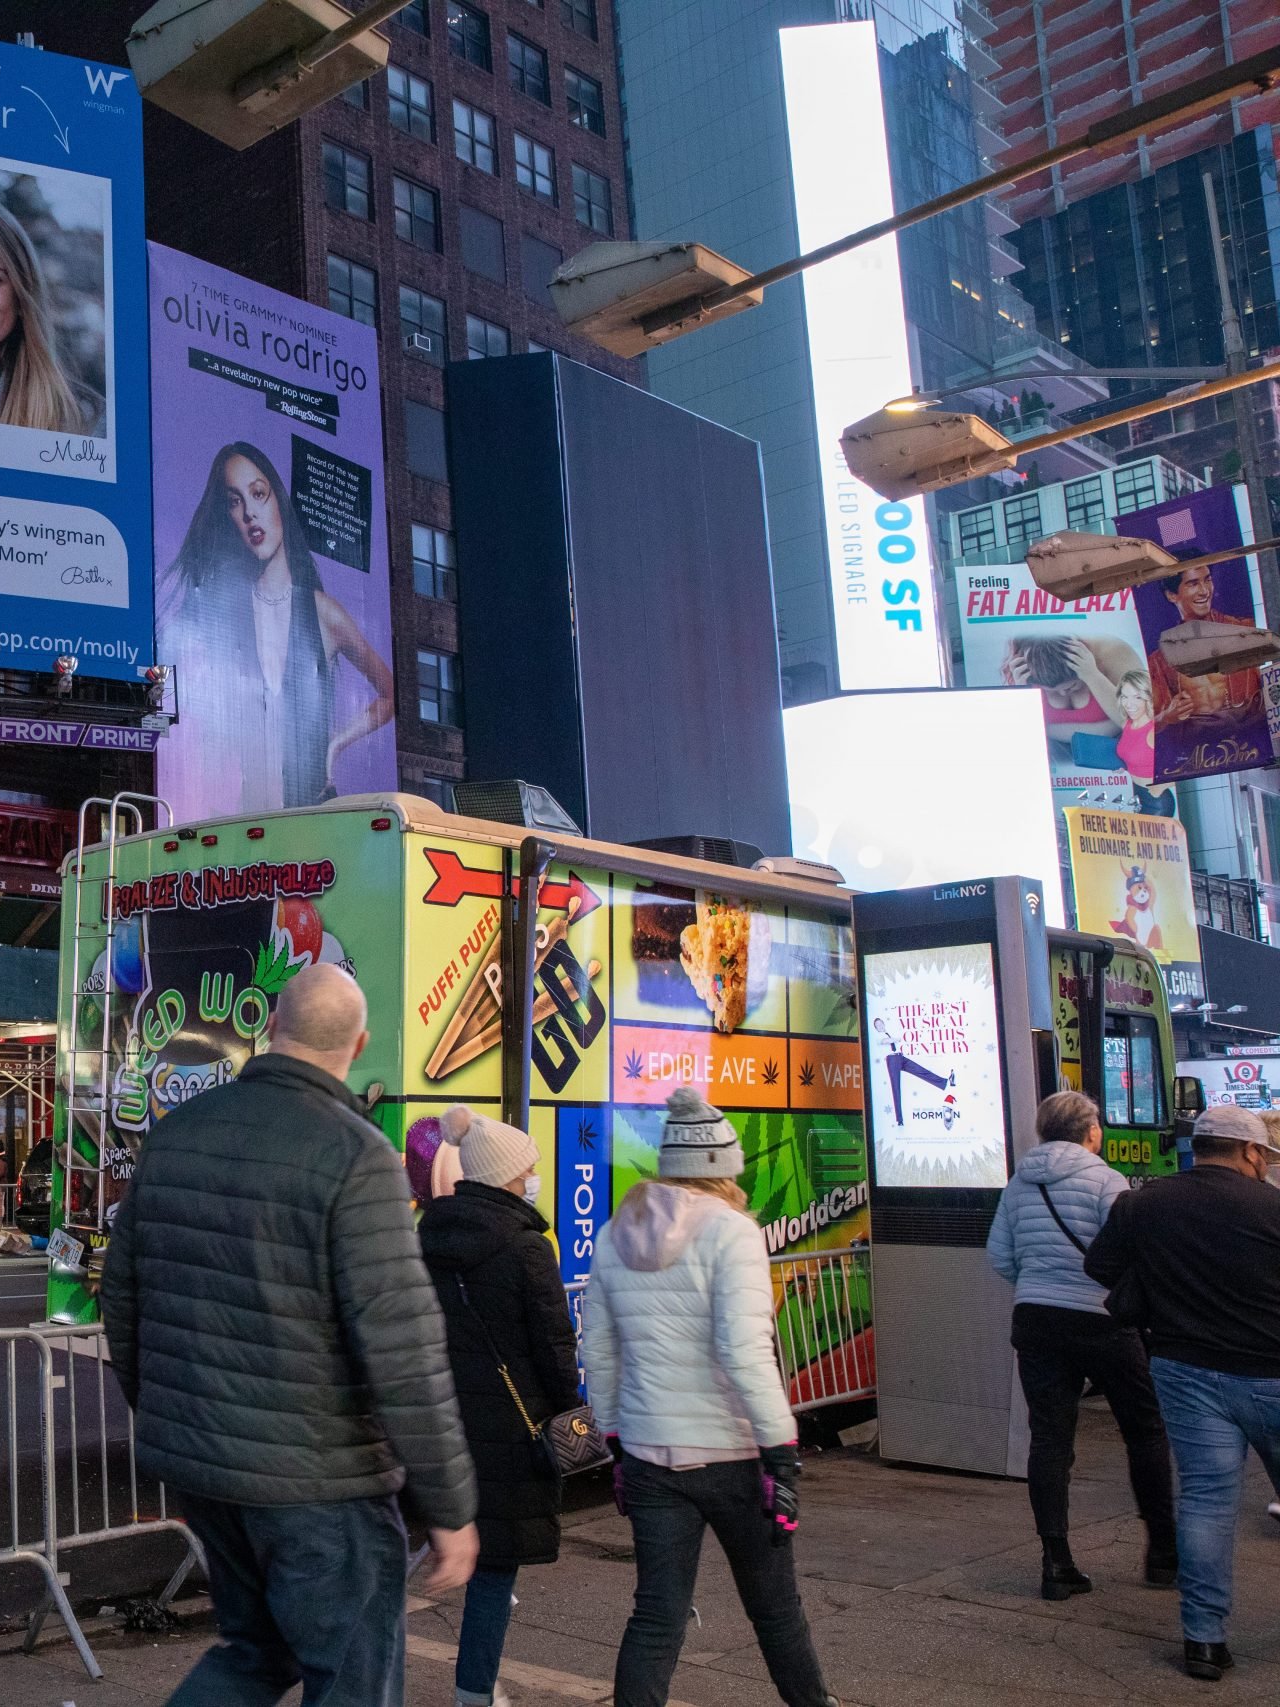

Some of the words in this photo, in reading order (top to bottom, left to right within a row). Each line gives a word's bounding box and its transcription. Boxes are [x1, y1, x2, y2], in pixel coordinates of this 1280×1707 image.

[83, 99, 125, 115] wingman
[201, 285, 230, 306] TIME
[289, 318, 338, 347] NOMINEE
[163, 293, 251, 350] olivia
[262, 331, 367, 391] rodrigo
[221, 364, 262, 387] revelatory
[264, 379, 281, 392] new
[282, 385, 298, 402] pop
[39, 440, 107, 474] Molly
[306, 454, 327, 468] Record
[348, 471, 360, 482] Year
[307, 465, 326, 478] Album
[347, 482, 359, 492] Year
[309, 476, 324, 489] Song
[344, 492, 357, 502] Year
[296, 491, 309, 502] Best
[309, 497, 320, 508] Pop
[321, 502, 334, 513] Solo
[311, 487, 324, 498] Best
[324, 493, 338, 504] New
[338, 500, 354, 511] Artist
[837, 481, 858, 514] LED
[301, 504, 314, 516] Best
[315, 510, 327, 521] Pop
[344, 521, 362, 535] Album
[308, 518, 321, 529] Best
[321, 523, 339, 536] Music
[339, 531, 356, 543] Video
[23, 522, 106, 547] wingman
[60, 566, 105, 586] Beth
[840, 523, 868, 605] SIGNAGE
[968, 575, 1010, 589] Feeling
[881, 578, 923, 632] SF
[966, 590, 1010, 617] FAT
[1014, 589, 1066, 615] AND
[92, 728, 153, 748] PRIME
[1080, 813, 1108, 833] THERE
[1110, 816, 1129, 836] WAS
[1130, 820, 1137, 837] A
[1172, 824, 1178, 841] A
[1137, 842, 1154, 860] AND
[1156, 844, 1162, 860] A
[181, 872, 200, 908] &
[933, 884, 987, 901] LinkNYC
[418, 960, 461, 1026] PUFF!
[459, 904, 501, 968] PUFF!
[82, 971, 105, 998] POPS
[894, 1004, 927, 1018] THE
[931, 1000, 969, 1016] BEST
[899, 1014, 969, 1030] MUSICAL
[903, 1029, 924, 1042] OF
[927, 1028, 965, 1042] THIS
[899, 1041, 969, 1056] CENTURY
[648, 1052, 714, 1083] EDIBLE
[719, 1055, 756, 1085] AVE
[821, 1063, 862, 1089] VAPE
[1224, 1083, 1245, 1091] TIMES
[574, 1164, 594, 1259] POPS
